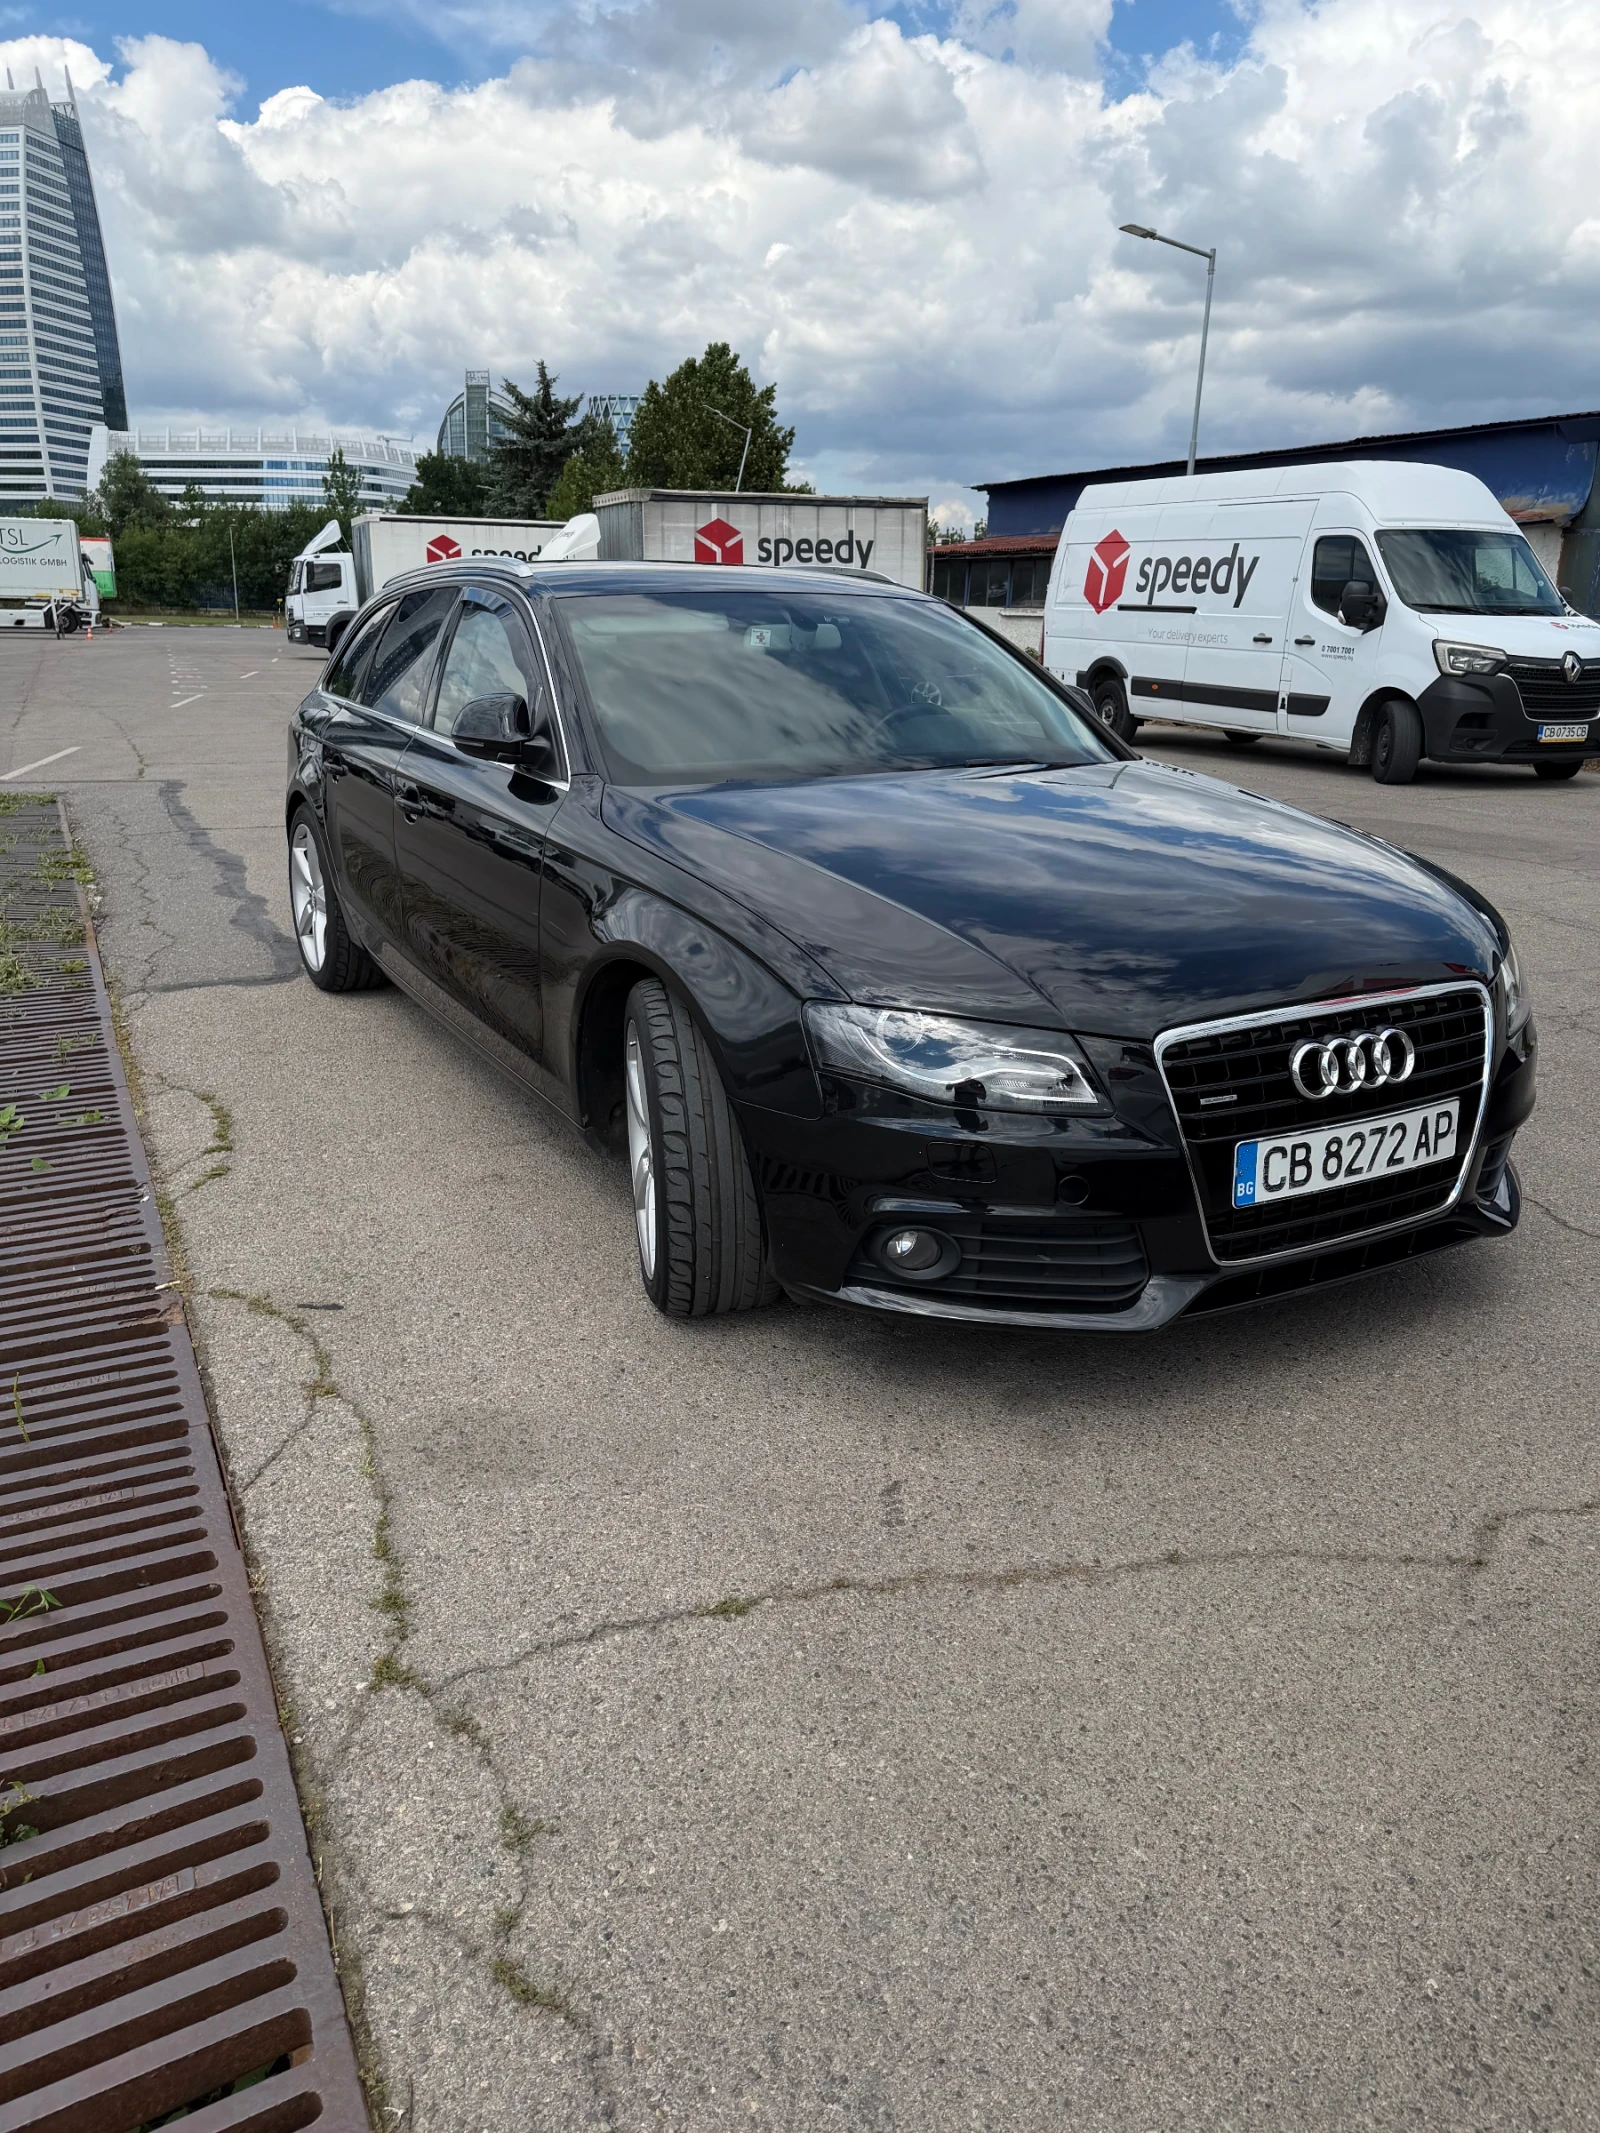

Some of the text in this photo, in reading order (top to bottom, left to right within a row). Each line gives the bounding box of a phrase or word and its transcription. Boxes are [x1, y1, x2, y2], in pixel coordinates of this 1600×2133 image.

[757, 529, 874, 569] speedy
[0, 556, 68, 567] OGISTIK GMBH
[1135, 542, 1260, 608] speedy
[1148, 627, 1229, 645] Your delivery experts
[1326, 645, 1340, 654] 7001
[1340, 646, 1355, 655] 7001
[1544, 727, 1556, 738] CB
[1556, 726, 1576, 738] 0735
[1576, 726, 1587, 737] CB
[1262, 1109, 1453, 1193] CB 8272 AP
[1236, 1181, 1254, 1197] BG
